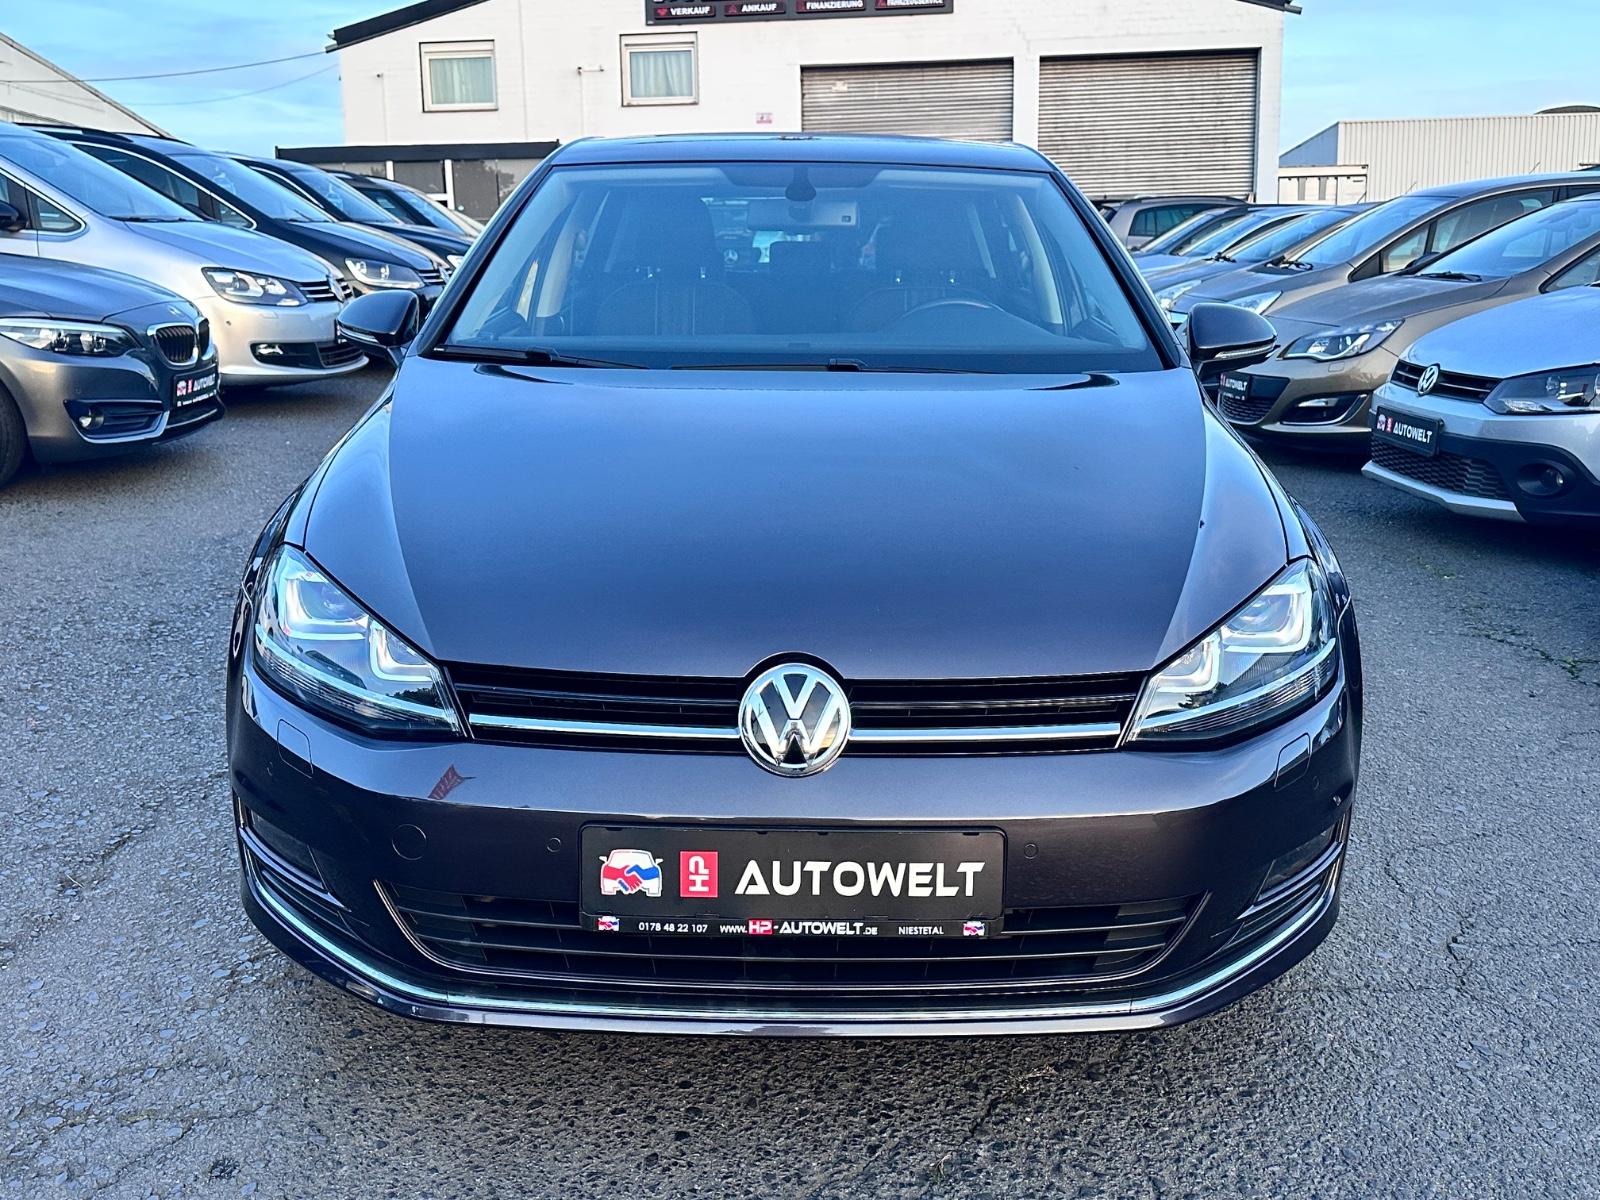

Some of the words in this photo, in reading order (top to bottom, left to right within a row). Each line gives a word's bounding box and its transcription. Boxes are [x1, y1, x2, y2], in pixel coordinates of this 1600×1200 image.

[741, 3, 777, 12] ANKAUF
[806, 0, 863, 10] FINANZIERUNG
[670, 6, 710, 16] VERKAUF
[1393, 422, 1433, 444] AUTOWELT
[734, 859, 986, 897] AUTOWELT
[638, 922, 661, 931] 0178
[663, 922, 675, 931] 48
[677, 923, 689, 932] 22
[692, 924, 708, 933] 107
[898, 926, 944, 935] NIESTETAL
